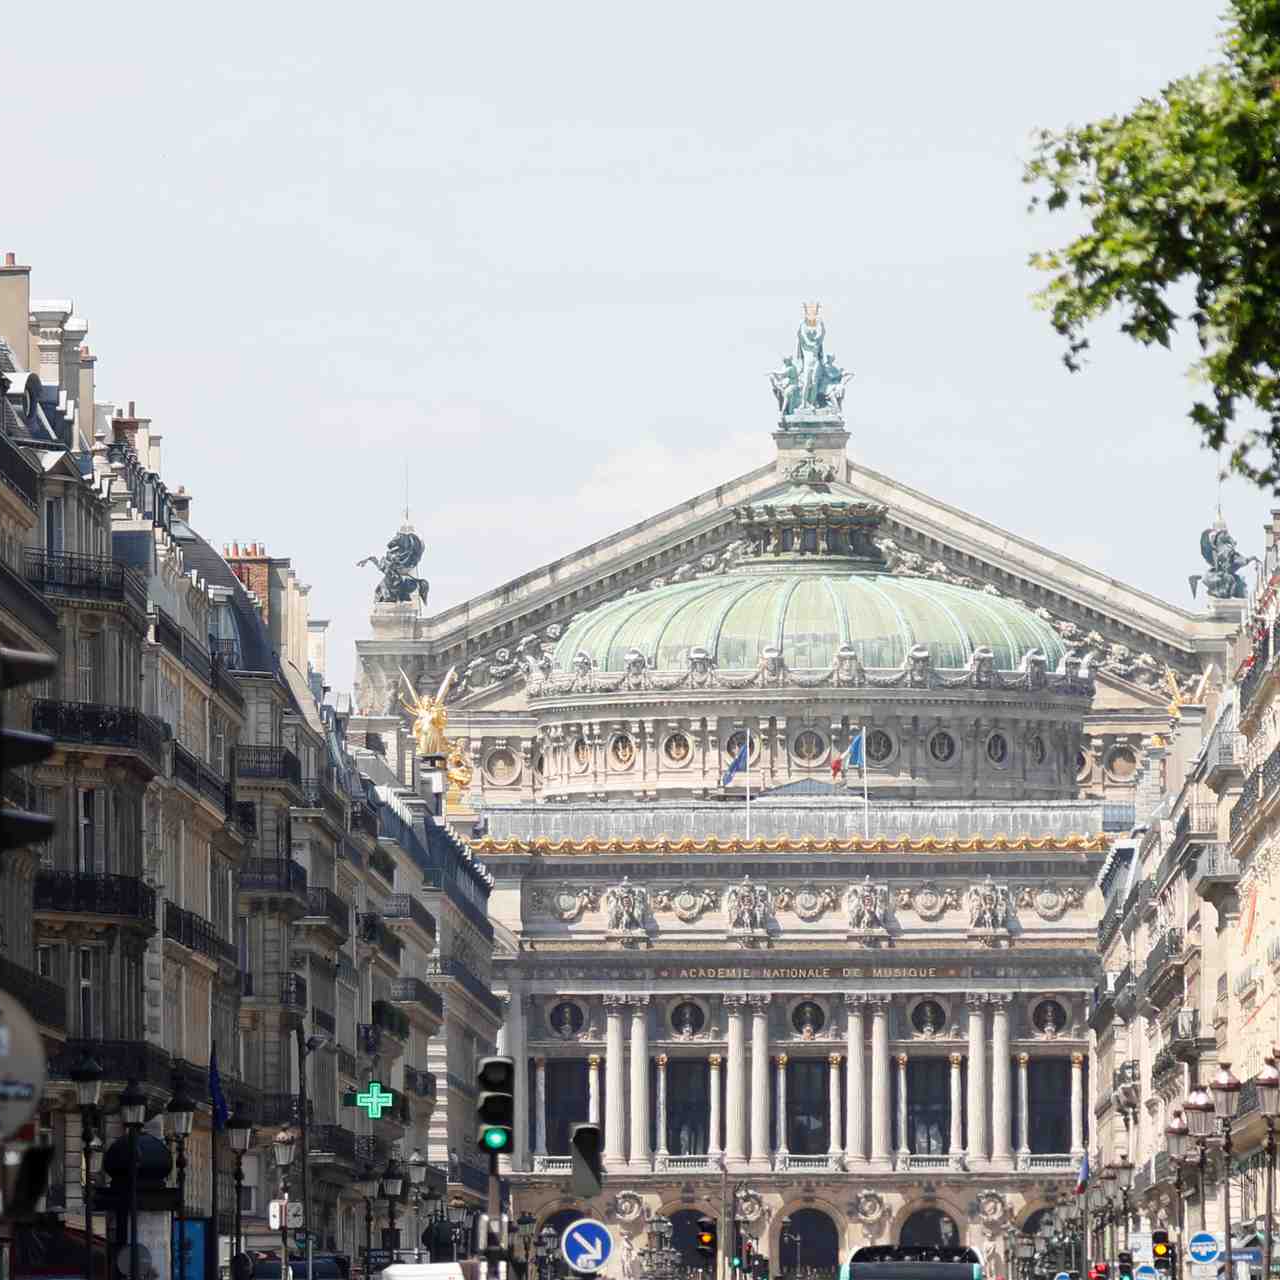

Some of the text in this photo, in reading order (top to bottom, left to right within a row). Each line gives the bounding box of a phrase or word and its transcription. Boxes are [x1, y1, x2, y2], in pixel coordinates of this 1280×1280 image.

[763, 968, 830, 978] NATIONALE
[843, 968, 863, 977] DE
[872, 968, 937, 978] MUSIQUE
